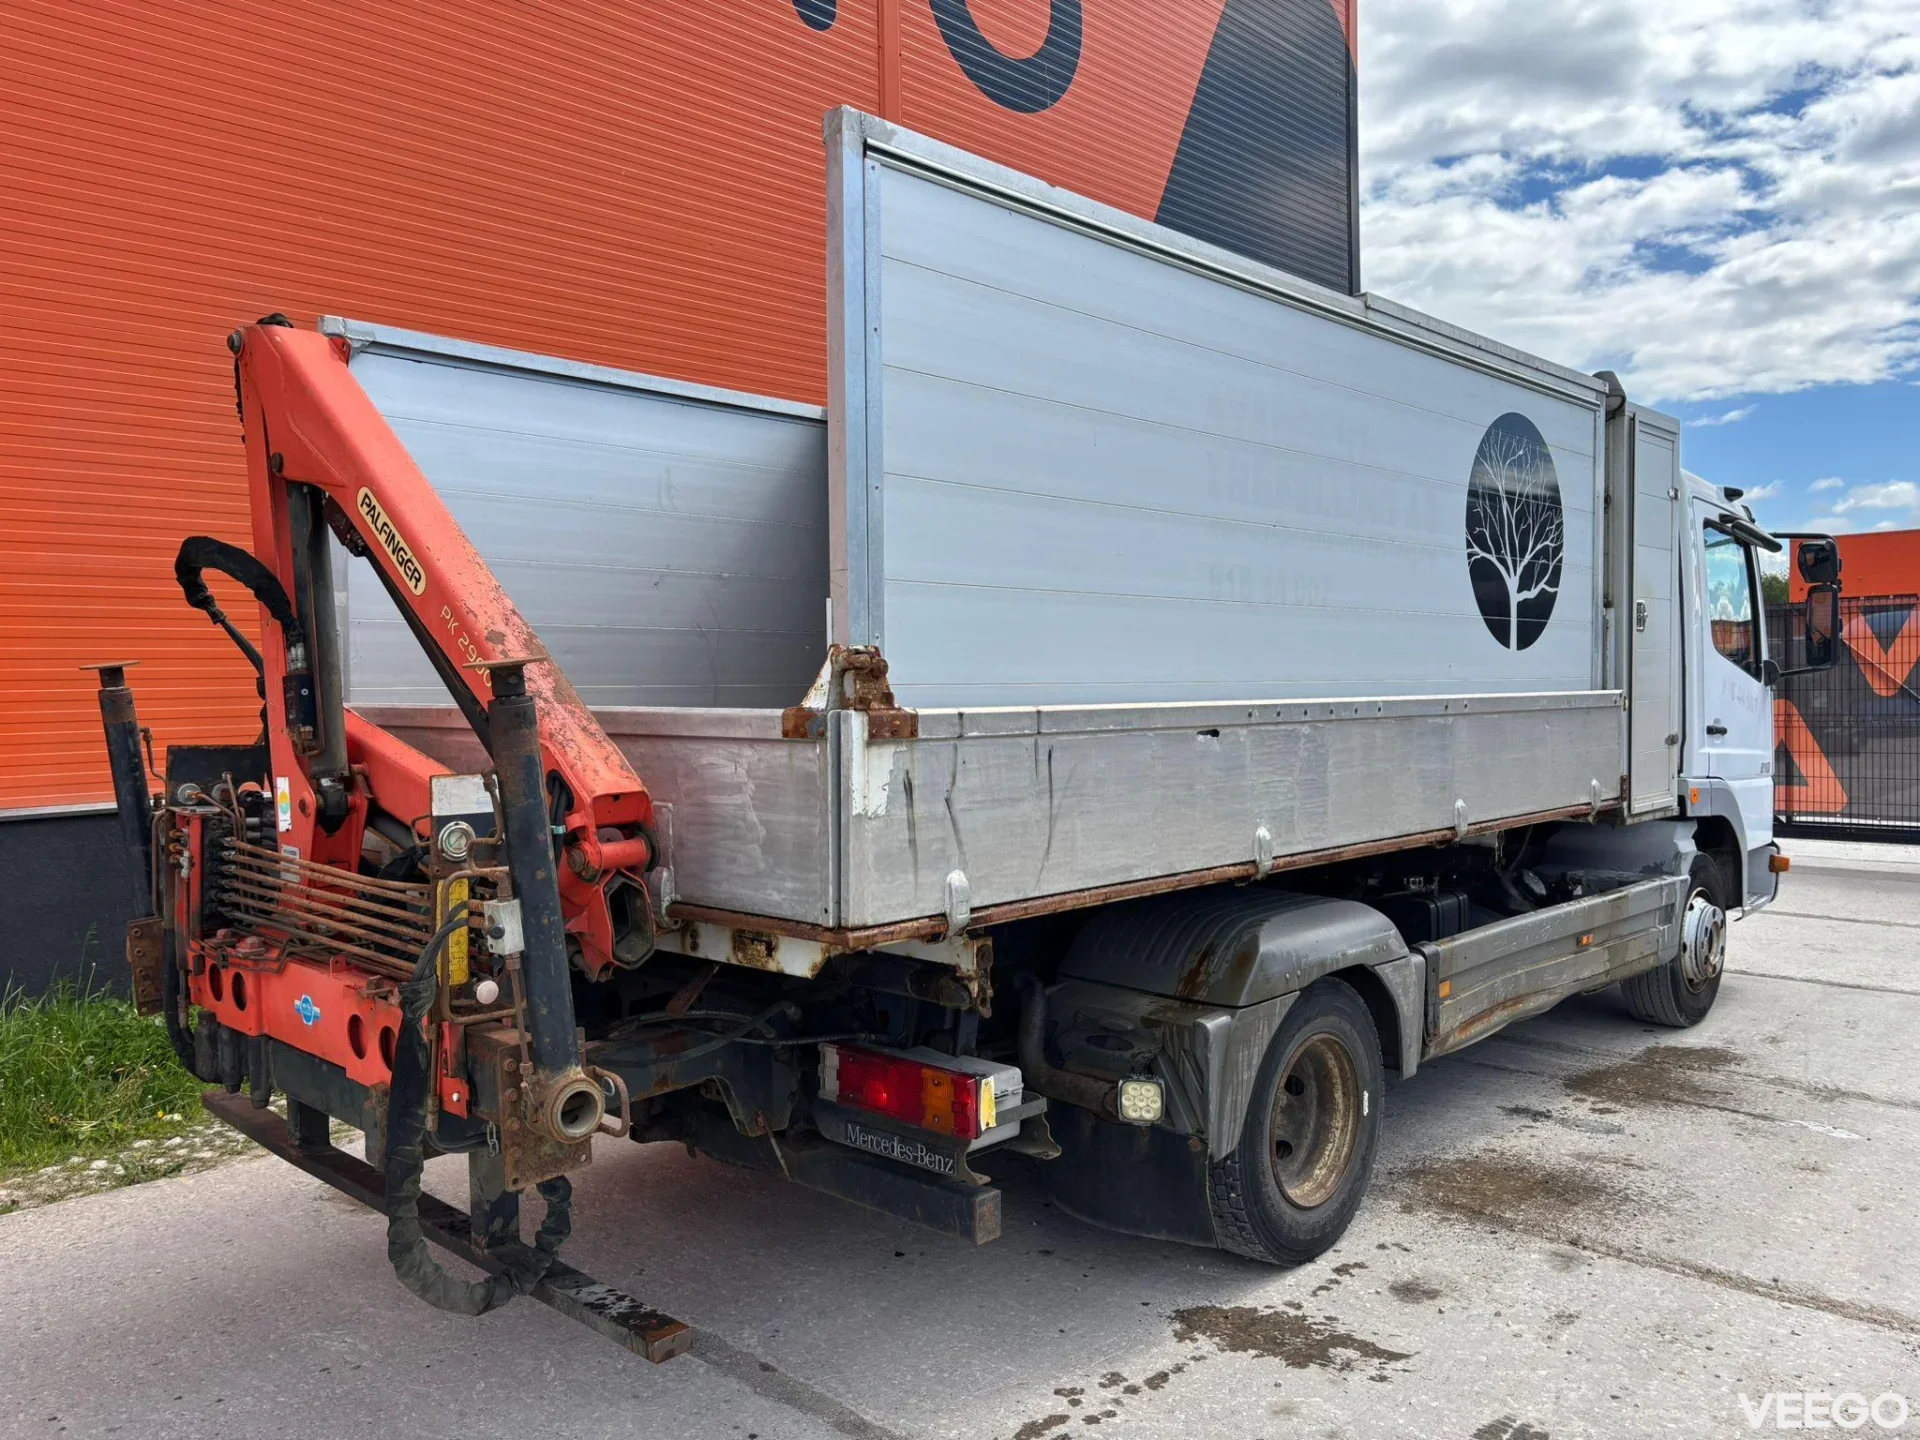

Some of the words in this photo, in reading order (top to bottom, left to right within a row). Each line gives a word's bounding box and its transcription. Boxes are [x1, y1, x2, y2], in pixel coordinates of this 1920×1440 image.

[360, 492, 422, 591] PALFINGER
[440, 605, 459, 636] PK
[847, 1123, 954, 1175] Mercedes-Benz
